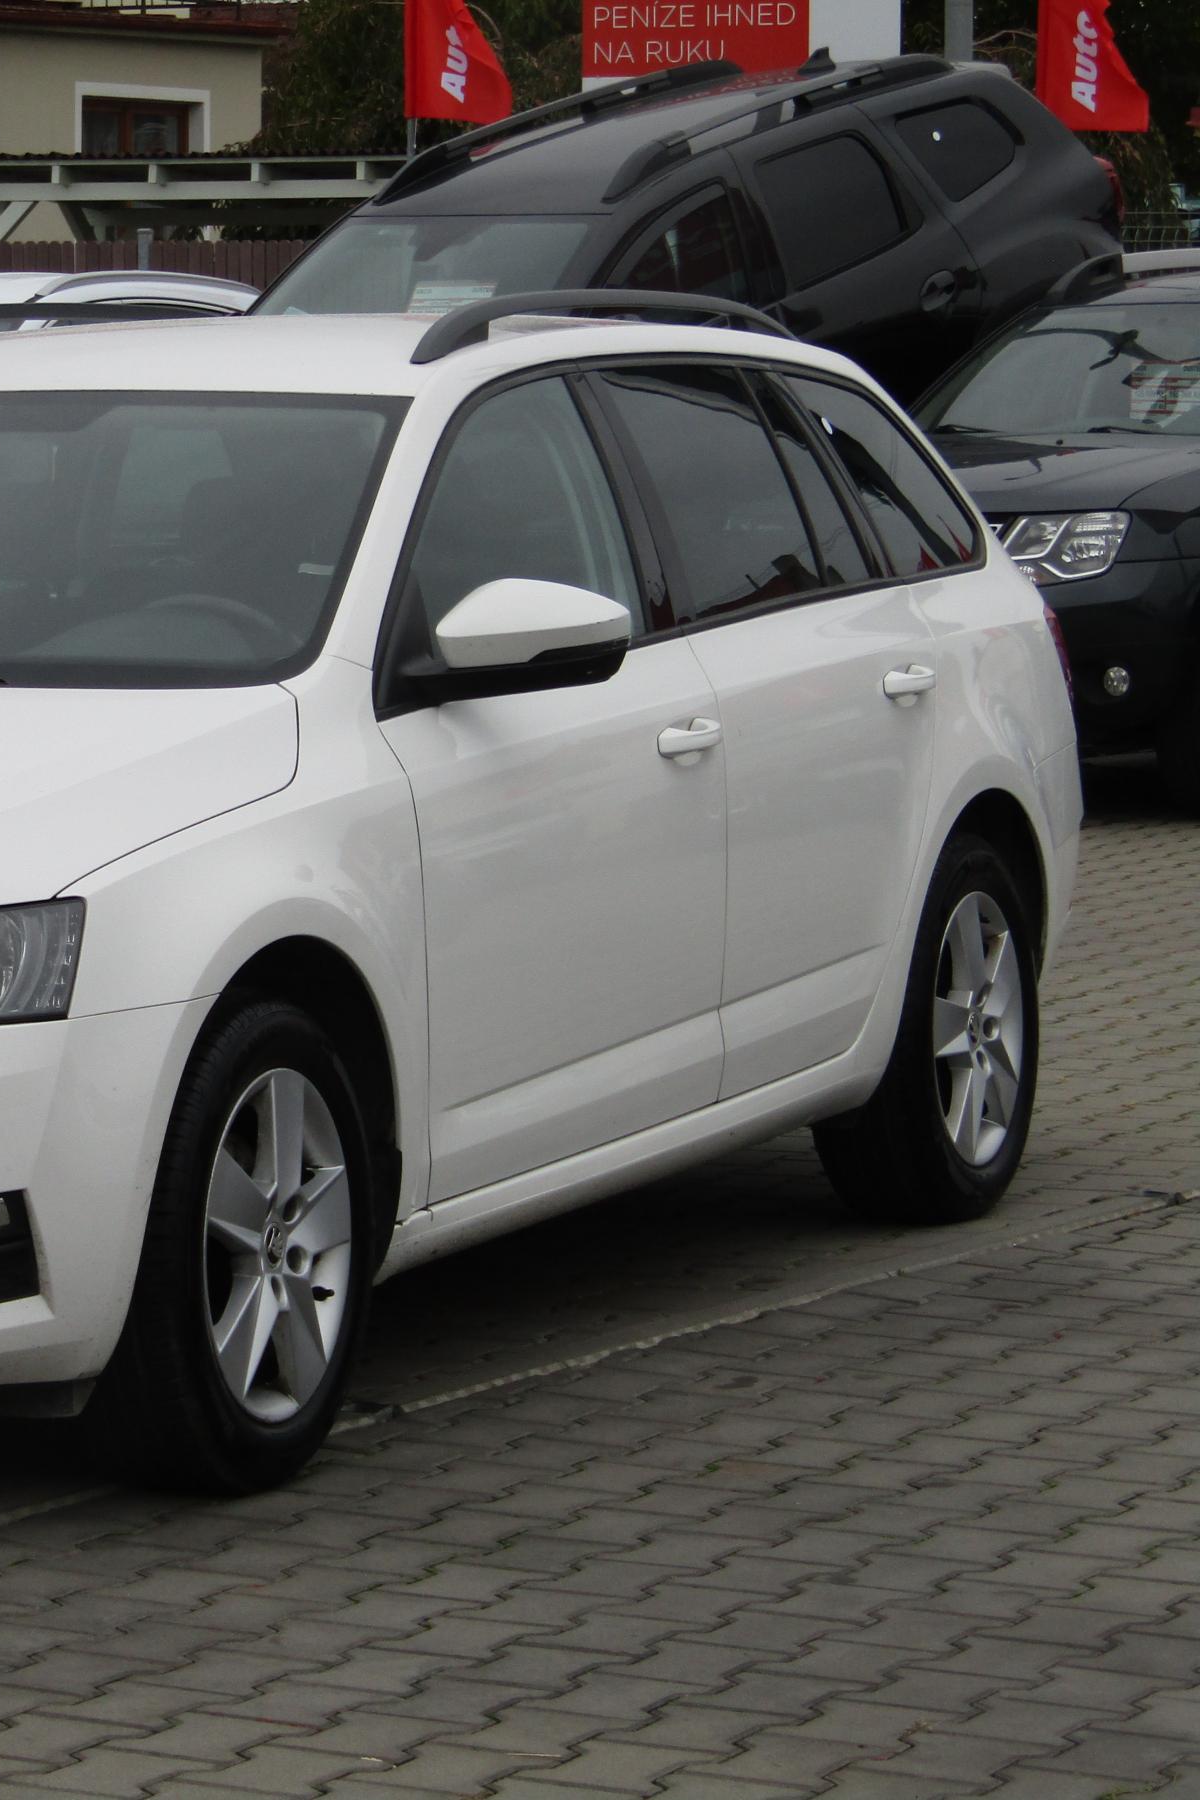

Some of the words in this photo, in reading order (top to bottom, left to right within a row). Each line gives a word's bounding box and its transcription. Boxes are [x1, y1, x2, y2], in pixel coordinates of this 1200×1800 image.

[594, 1, 695, 29] PENÍZE
[706, 2, 796, 27] IHNED
[594, 40, 635, 64] NA
[645, 39, 725, 63] RUKU
